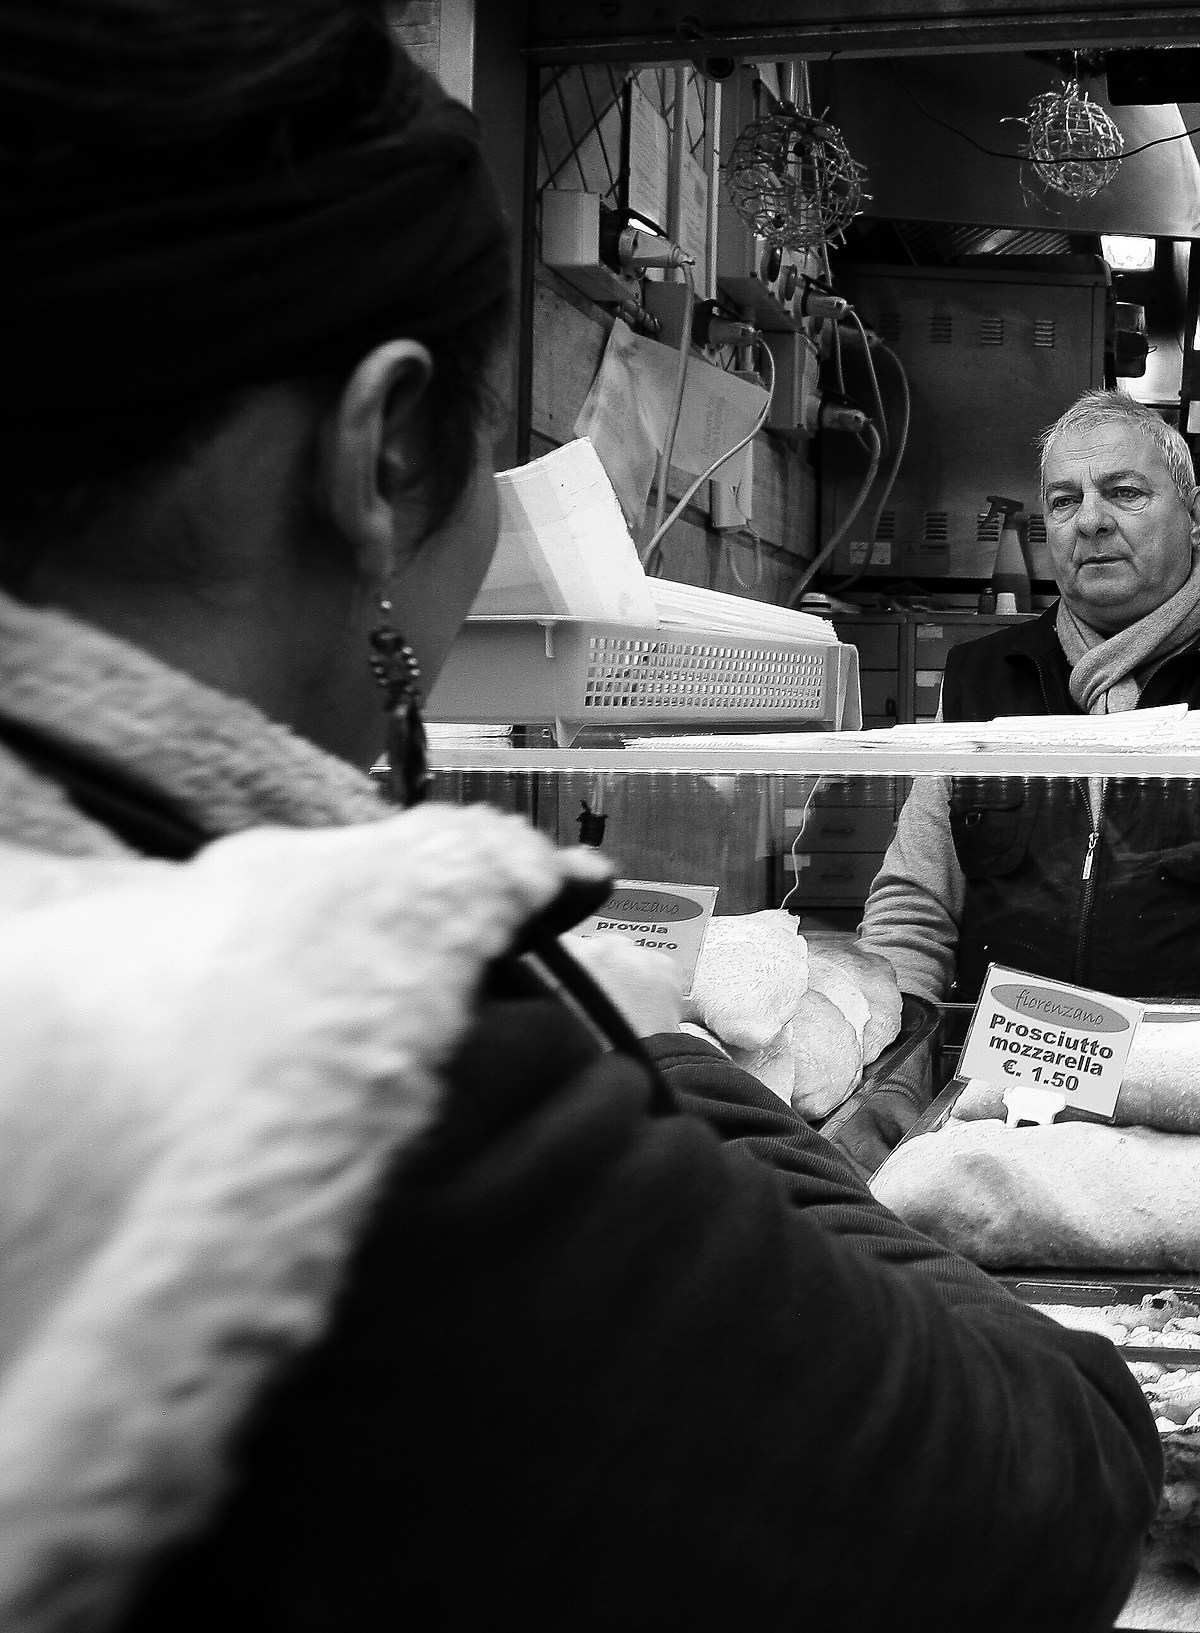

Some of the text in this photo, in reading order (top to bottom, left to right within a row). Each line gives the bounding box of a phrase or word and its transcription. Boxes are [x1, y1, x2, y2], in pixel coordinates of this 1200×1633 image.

[603, 899, 681, 915] orenzano
[596, 921, 669, 935] provola
[1014, 988, 1105, 1027] fiorenzano
[989, 1013, 1114, 1060] Prosciutto
[989, 1034, 1104, 1077] mozzarella
[1031, 1066, 1080, 1091] 1.50
